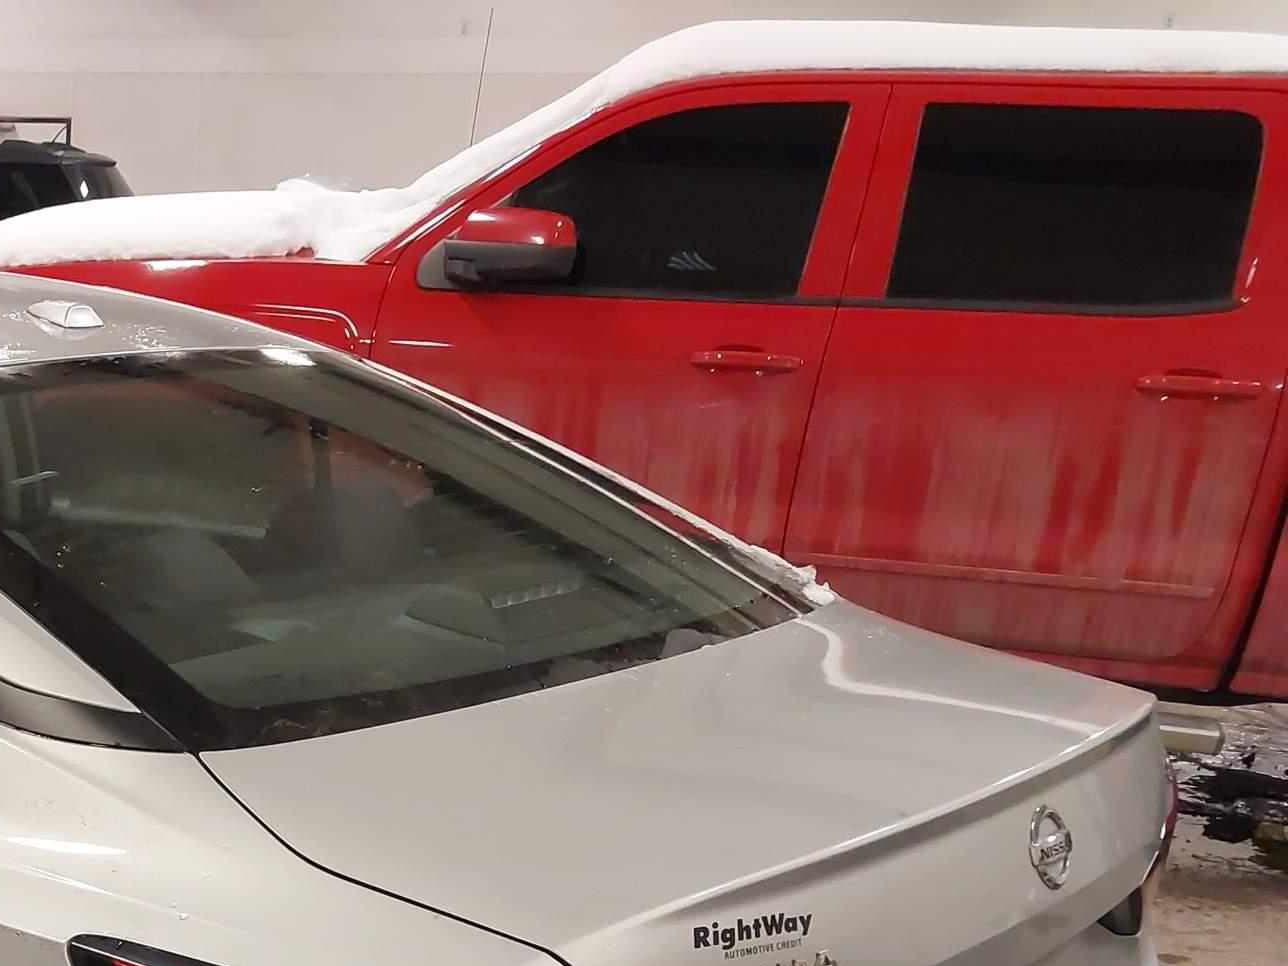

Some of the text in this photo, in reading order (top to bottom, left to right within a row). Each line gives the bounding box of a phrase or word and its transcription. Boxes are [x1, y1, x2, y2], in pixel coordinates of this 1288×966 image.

[693, 912, 812, 950] RightWay
[724, 938, 802, 960] AUTOMOTIVE CREDIT
